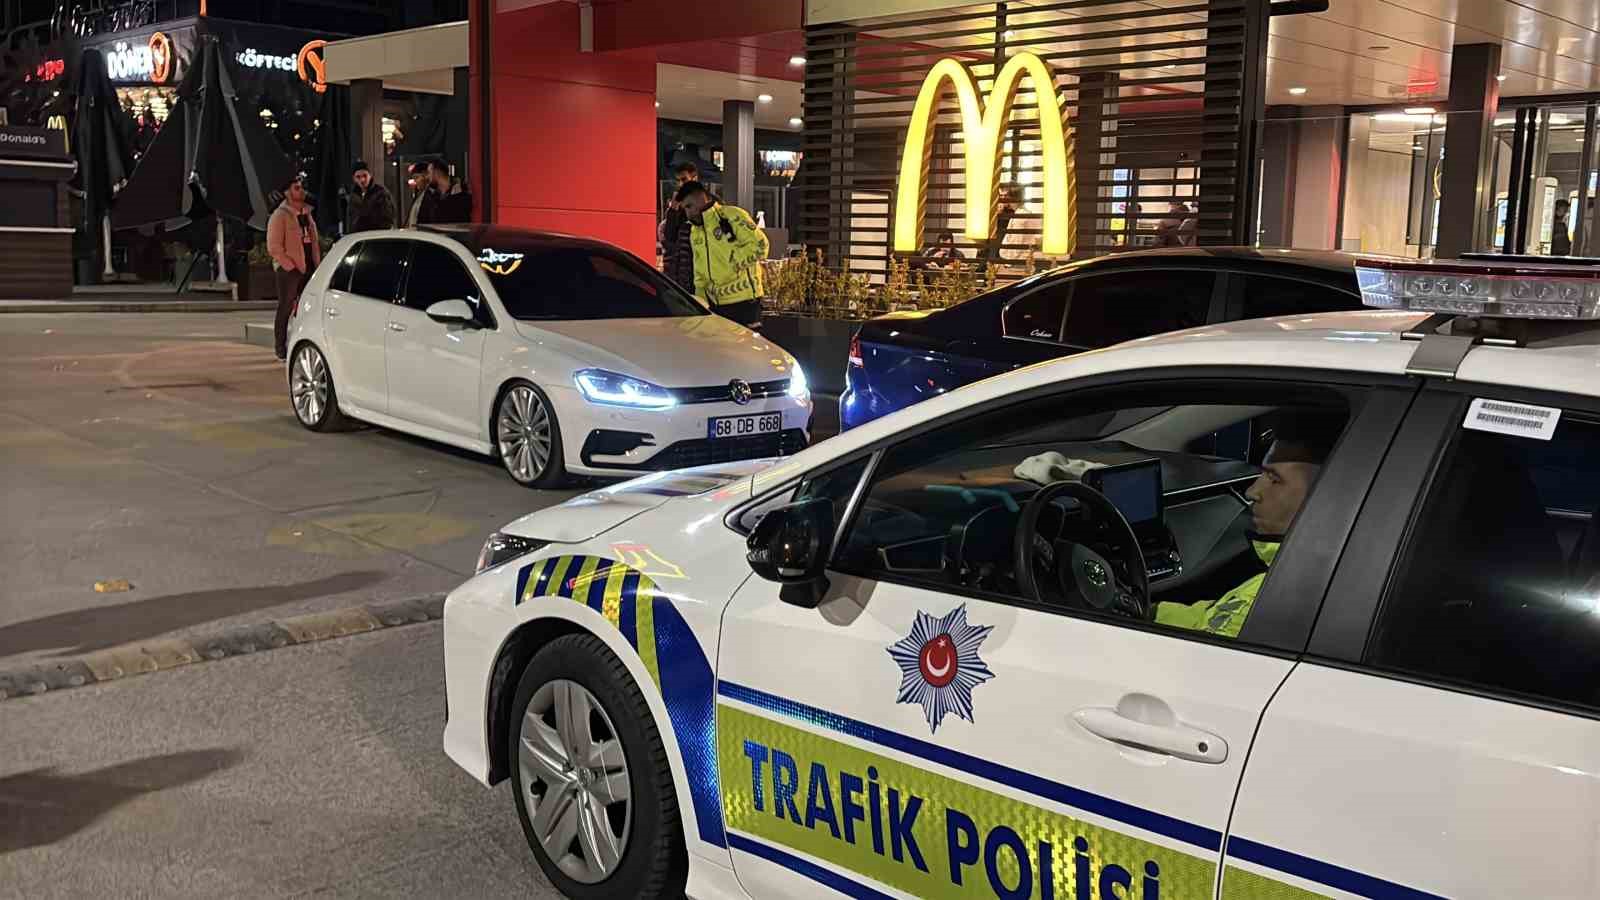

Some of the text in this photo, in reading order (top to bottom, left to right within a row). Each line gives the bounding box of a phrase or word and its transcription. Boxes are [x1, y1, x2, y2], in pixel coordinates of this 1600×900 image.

[716, 420, 732, 436] 68
[737, 418, 754, 434] DB
[759, 415, 779, 432] 668
[743, 738, 930, 874] TRAFİK
